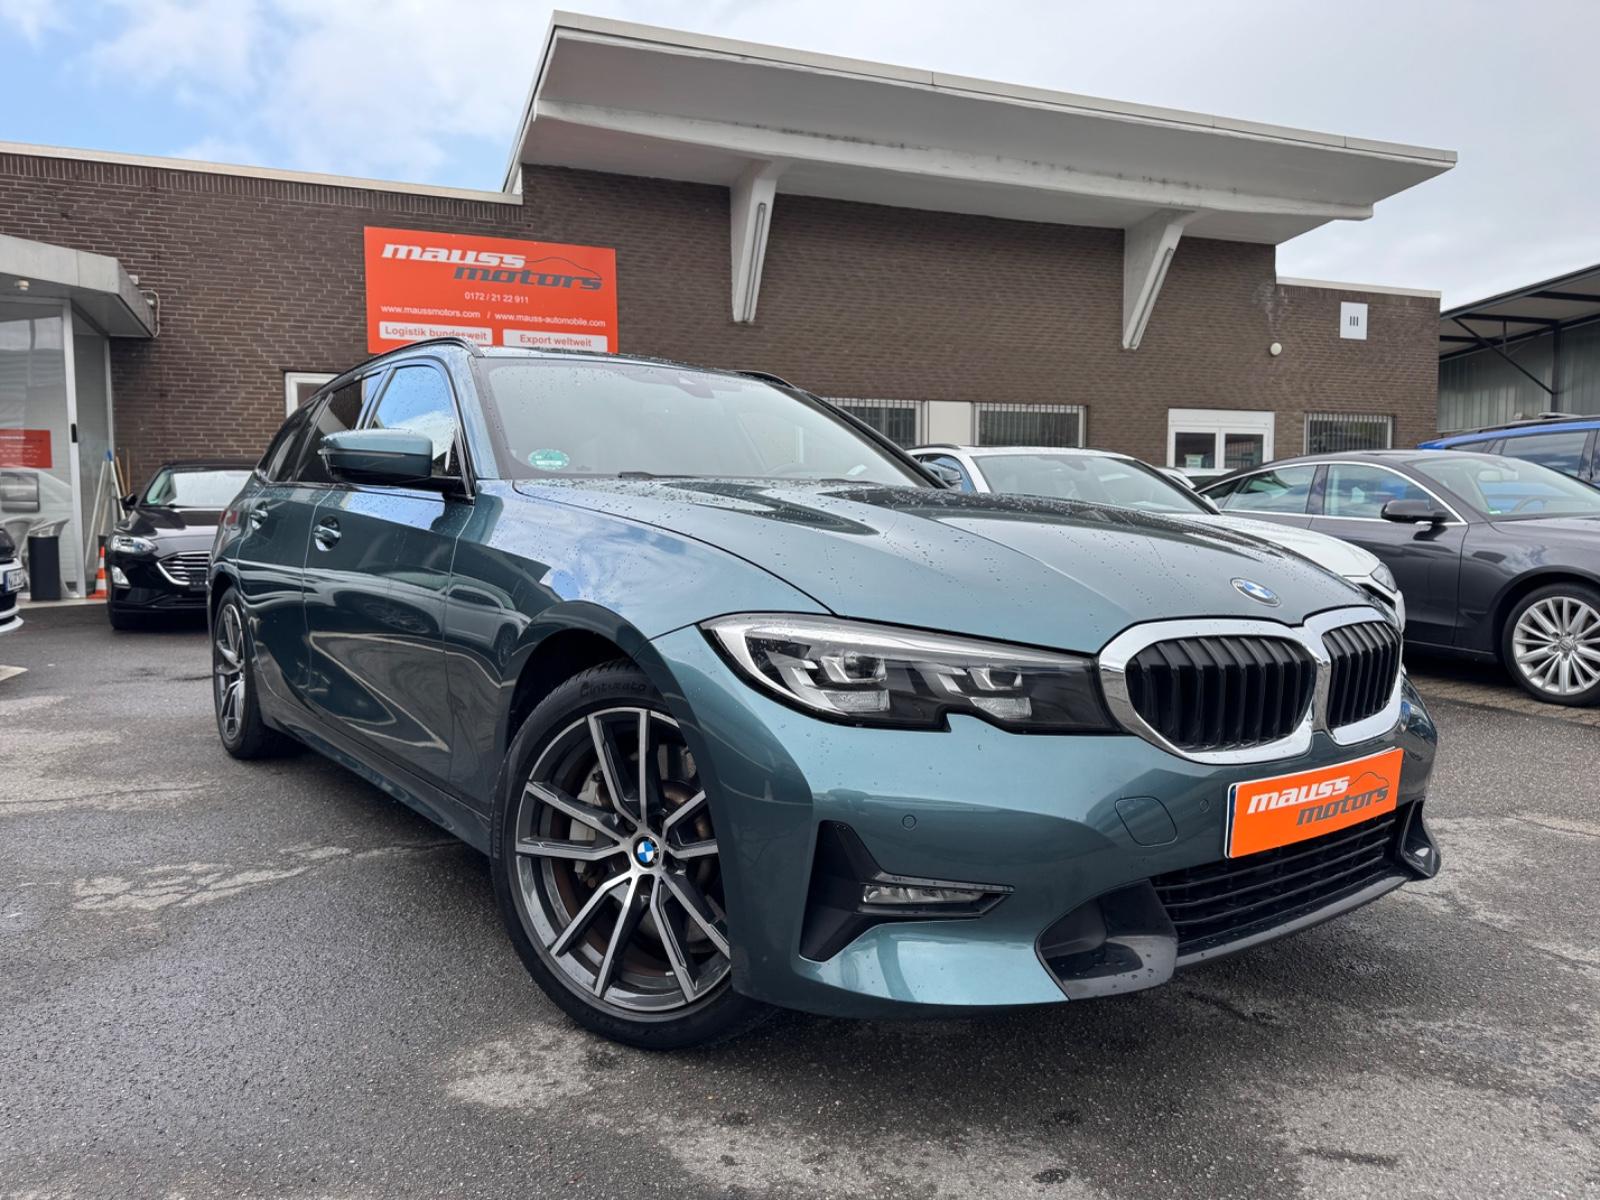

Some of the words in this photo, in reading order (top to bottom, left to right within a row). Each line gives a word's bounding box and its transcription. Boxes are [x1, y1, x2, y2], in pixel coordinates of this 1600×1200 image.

[381, 243, 526, 269] mauss
[454, 265, 602, 291] motors
[464, 291, 485, 301] 0172
[491, 292, 501, 302] 21
[502, 293, 514, 303] 22
[514, 294, 529, 304] 911
[380, 305, 481, 319] www.maussmotors.com
[494, 312, 606, 328] www.mauss-automobile.com
[384, 326, 426, 337] Logistik
[520, 334, 551, 345] Export
[554, 338, 592, 347] weltweit
[1246, 776, 1350, 815] mauss
[1296, 787, 1389, 826] motors
